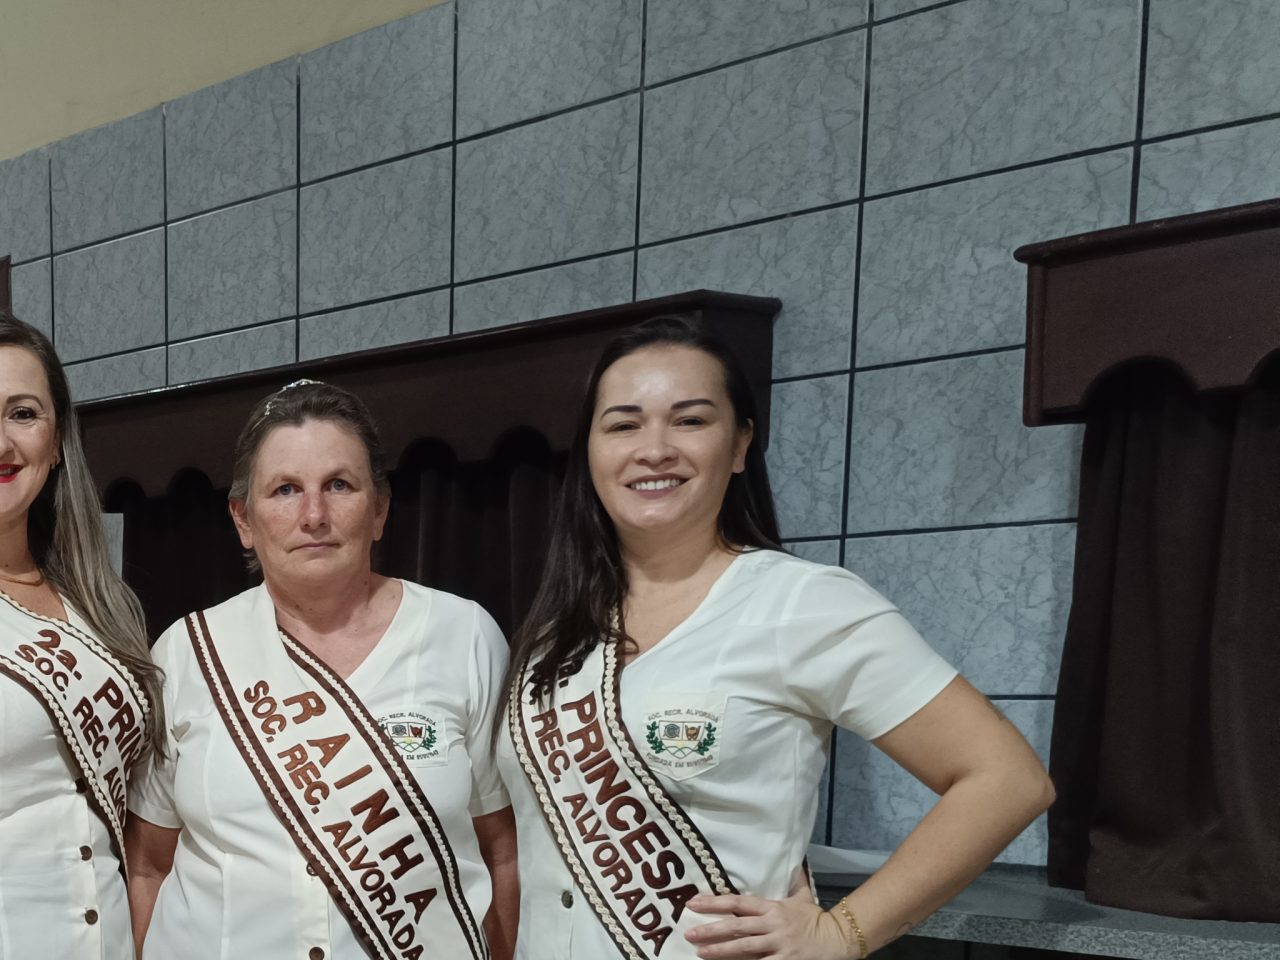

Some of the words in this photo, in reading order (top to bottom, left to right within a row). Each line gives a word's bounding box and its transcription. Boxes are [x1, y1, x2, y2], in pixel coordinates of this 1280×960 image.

[15, 644, 69, 700] SOC.
[72, 696, 109, 766] REC.
[244, 680, 287, 743] SOC.
[277, 743, 330, 814] REC.
[283, 691, 437, 925] RAINHA
[561, 691, 699, 924] PRINCESA
[531, 708, 570, 784] REC.
[563, 792, 673, 957] ALVORADA
